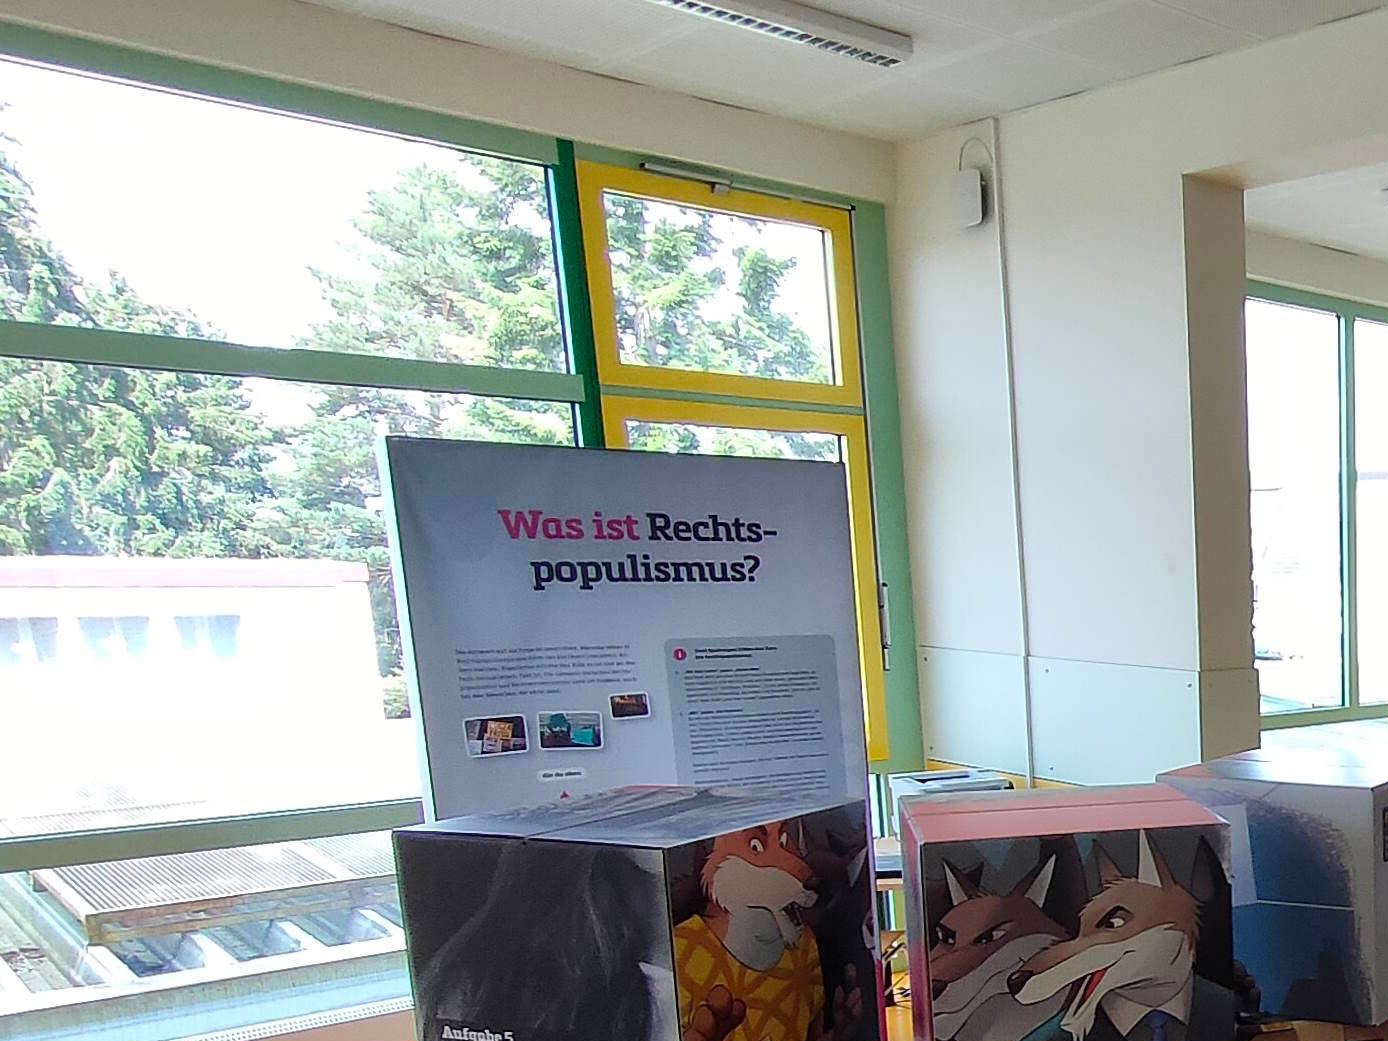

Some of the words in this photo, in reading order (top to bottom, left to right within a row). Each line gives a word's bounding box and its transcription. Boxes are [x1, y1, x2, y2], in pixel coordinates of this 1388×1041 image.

[498, 509, 584, 541] Was
[593, 511, 640, 542] ist
[646, 513, 779, 544] Rechts-
[531, 554, 761, 591] populismus?
